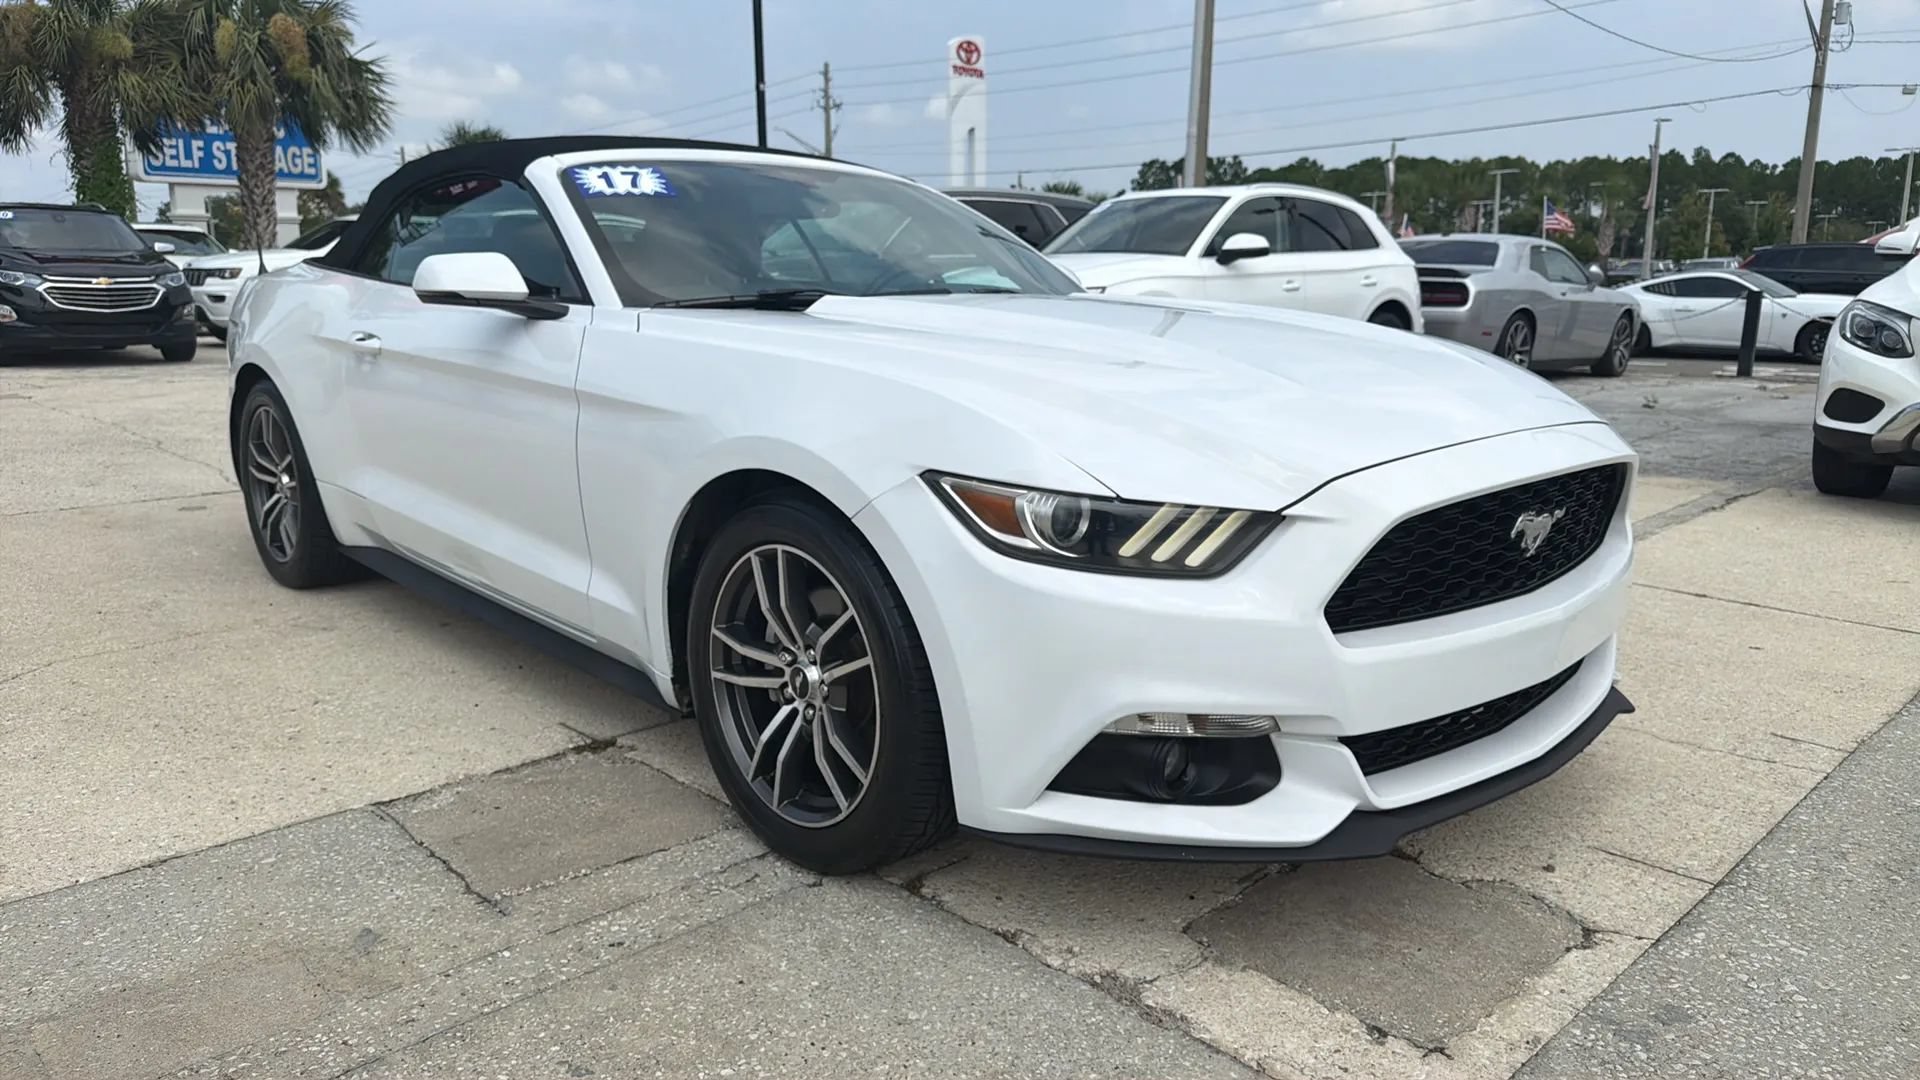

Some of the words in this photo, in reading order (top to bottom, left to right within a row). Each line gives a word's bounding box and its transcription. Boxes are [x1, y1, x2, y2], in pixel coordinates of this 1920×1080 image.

[952, 65, 984, 79] TOYOTA
[211, 140, 316, 175] STAGE
[597, 171, 641, 189] 17
